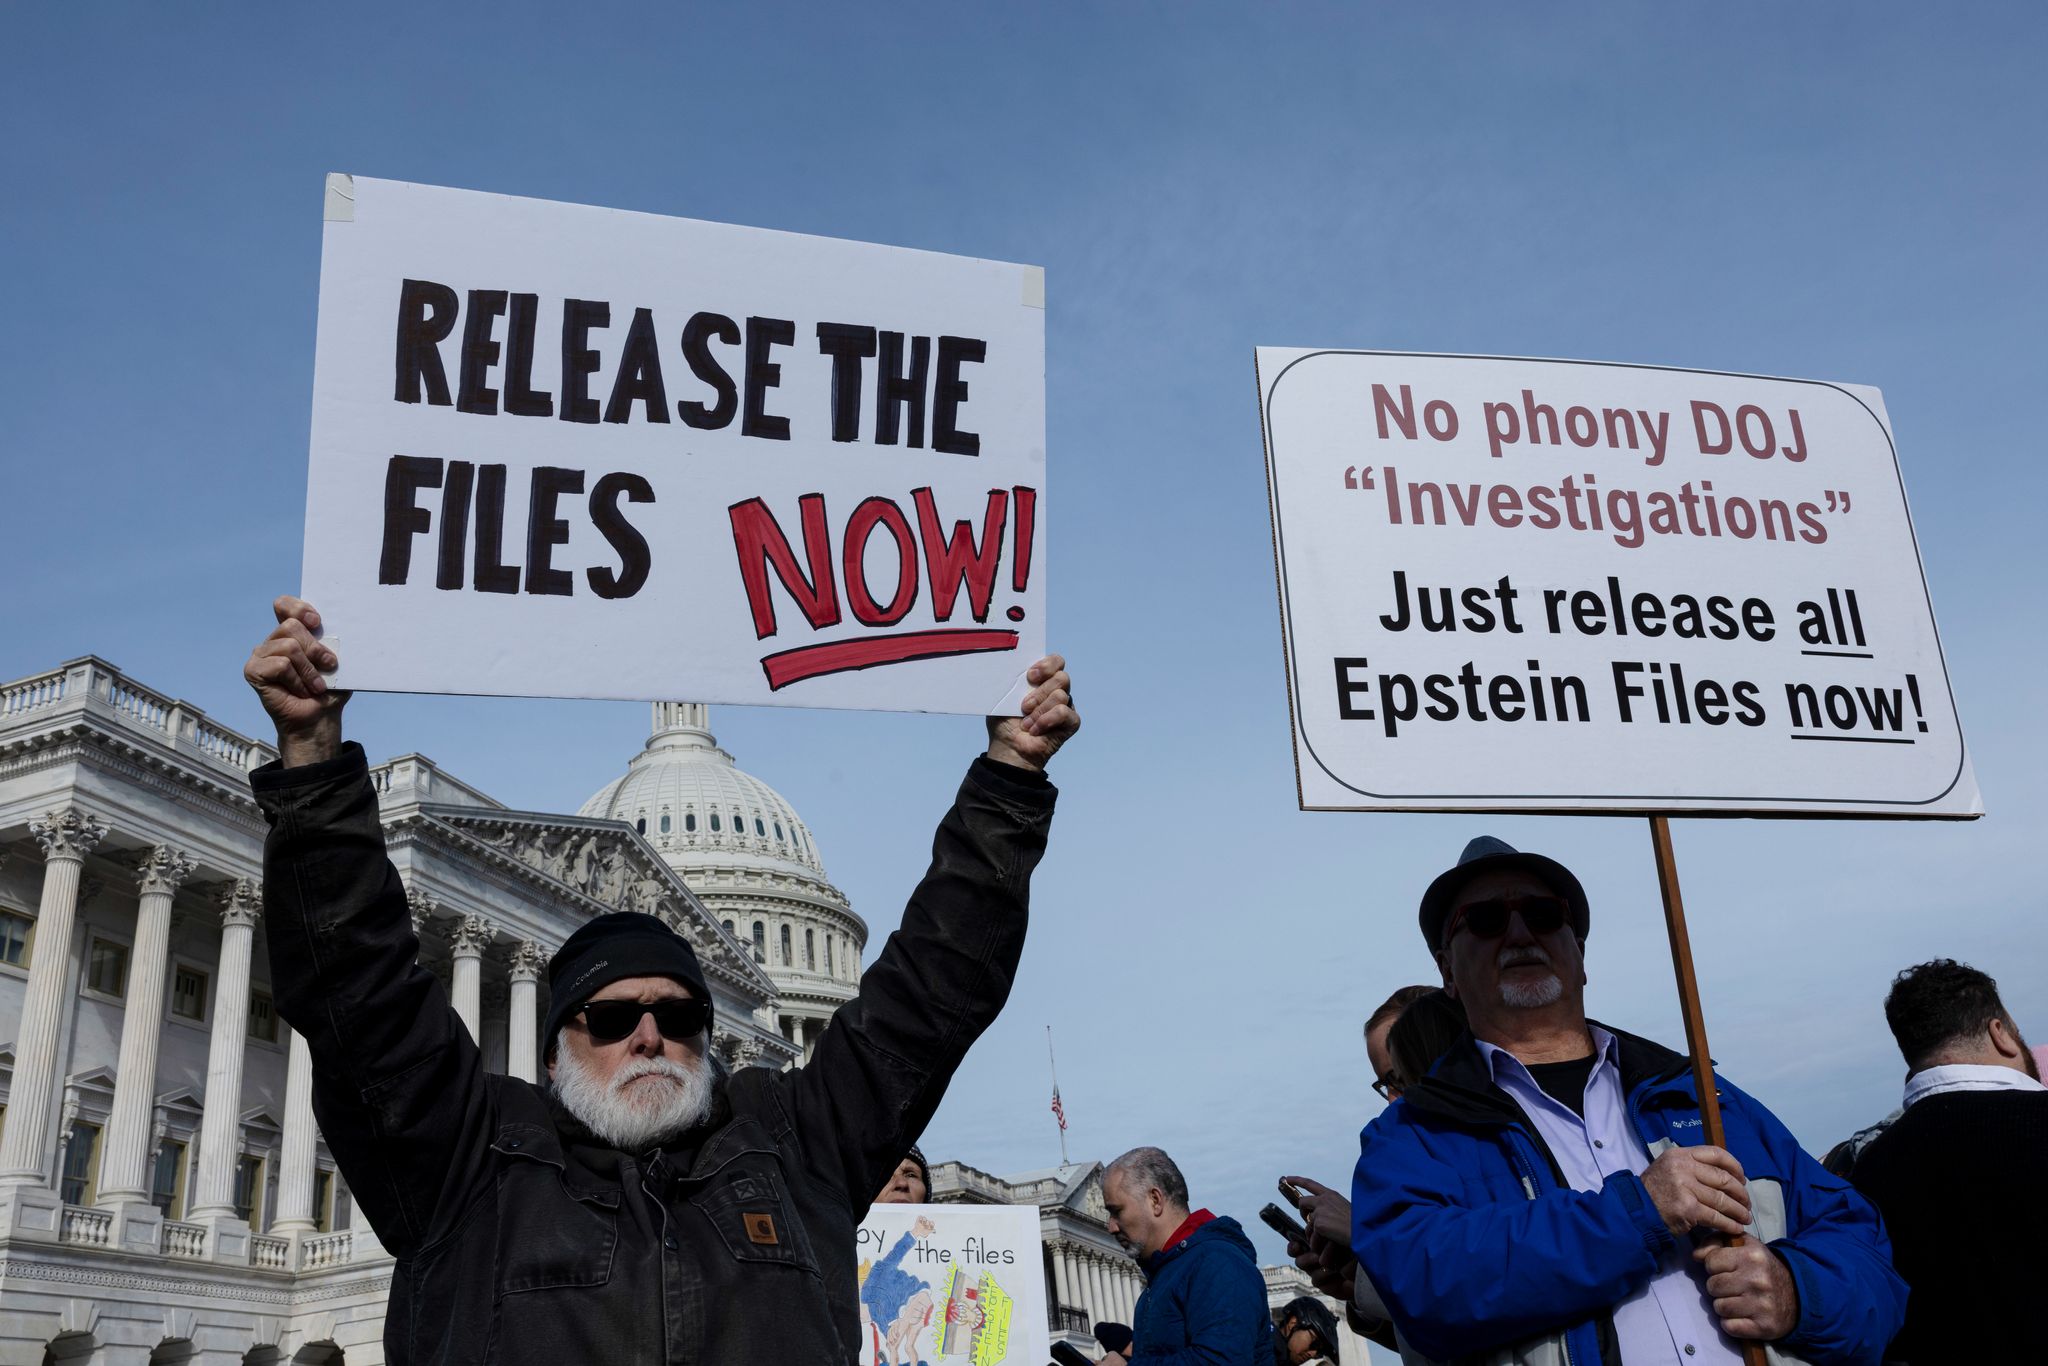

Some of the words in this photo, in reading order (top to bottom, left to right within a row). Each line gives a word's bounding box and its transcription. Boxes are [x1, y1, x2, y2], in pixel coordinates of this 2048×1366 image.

[394, 278, 796, 441] RELEASE
[815, 321, 987, 458] THE
[1371, 383, 1460, 442] No
[1483, 389, 1670, 467] phony
[1689, 400, 1809, 463] DOJ
[1344, 465, 1852, 549] “Investigations”
[378, 454, 657, 600] FILES
[727, 484, 1038, 642] NOW!
[1378, 570, 1524, 634] Just
[1542, 575, 1776, 643] release
[1797, 587, 1868, 647] all
[1333, 656, 1591, 738] Epstein
[1610, 660, 1767, 727] Files
[1784, 673, 1930, 735] now!
[575, 960, 609, 986] Columbia
[914, 1240, 952, 1264] the
[961, 1236, 1016, 1265] files
[980, 1285, 999, 1366] EPSTEIN
[996, 1296, 1012, 1356] FILES
